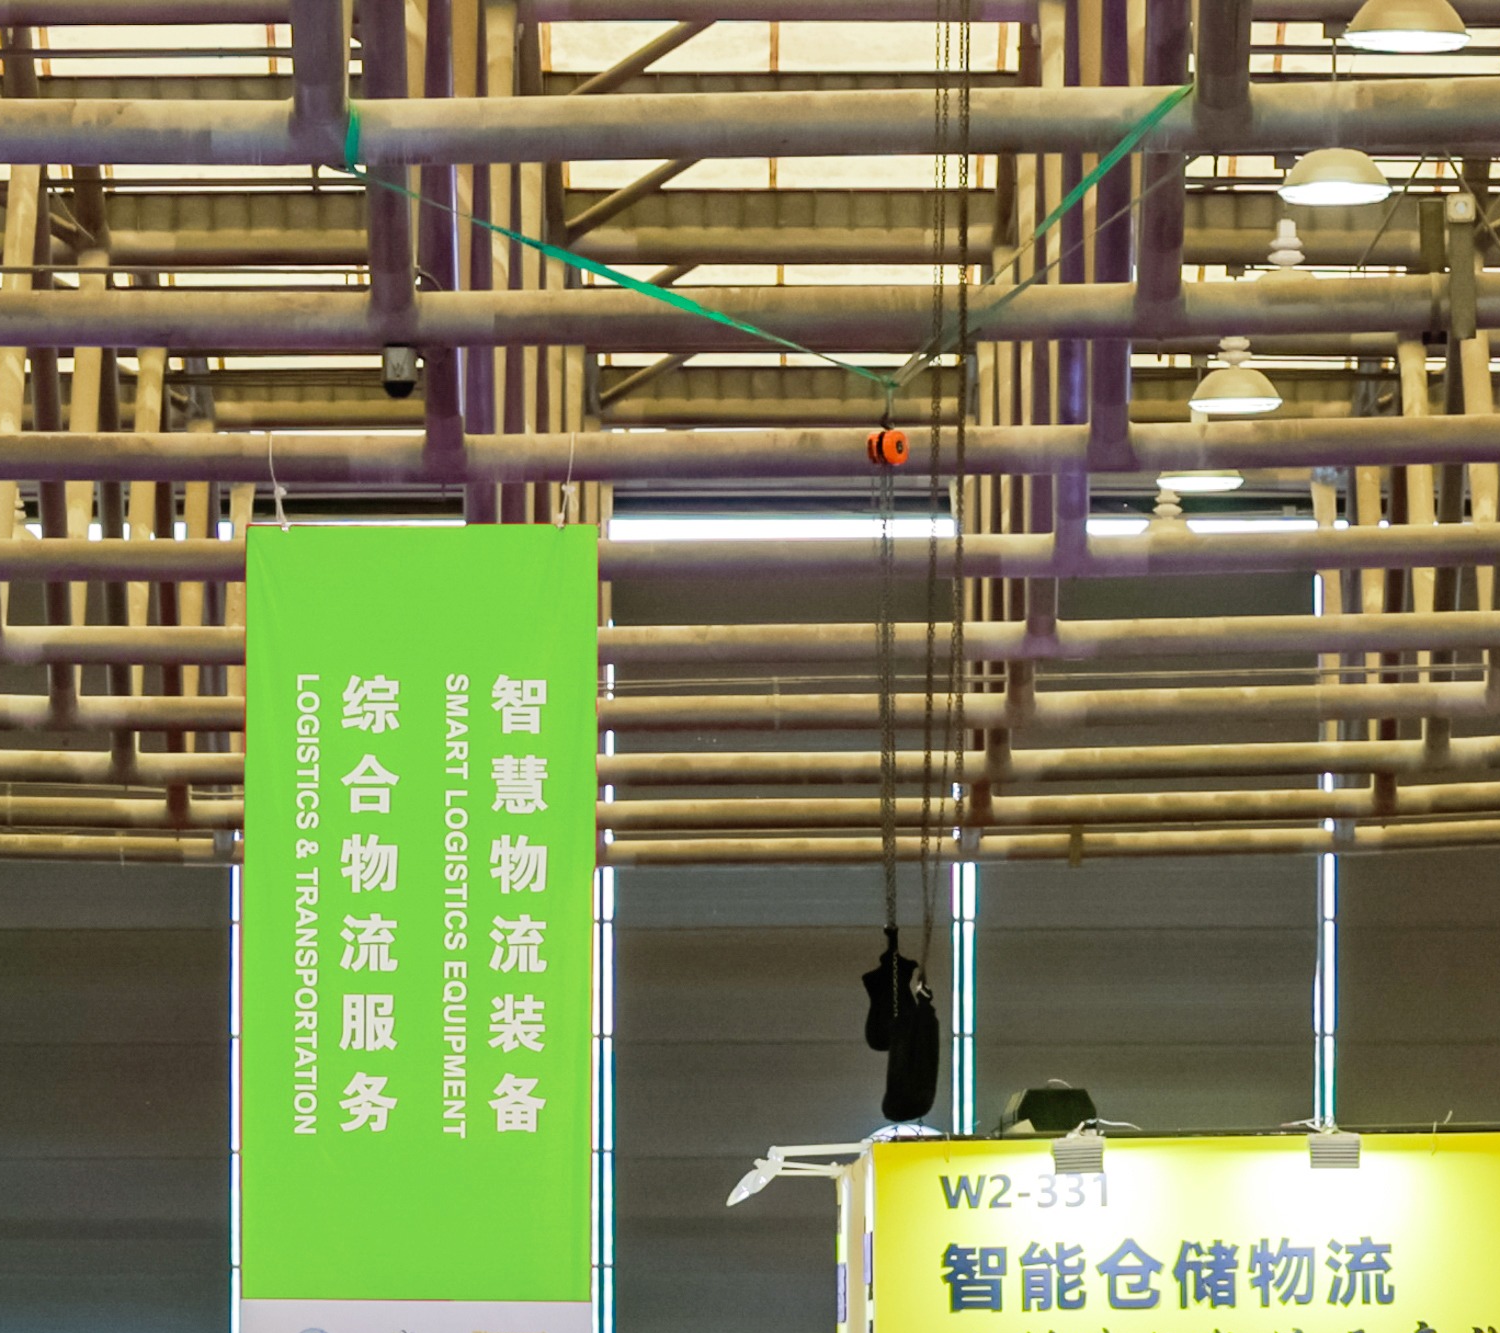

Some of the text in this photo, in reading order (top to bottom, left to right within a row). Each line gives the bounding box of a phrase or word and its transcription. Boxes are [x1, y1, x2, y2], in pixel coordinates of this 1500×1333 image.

[293, 673, 320, 1136] LOGISTICS & TRANSPORTATION
[339, 674, 400, 1135] 综合物流服务
[442, 673, 470, 1140] SMART LOGISTICS EQUIPMENT
[488, 674, 549, 1134] 智慧物流装备
[939, 1172, 1110, 1210] W2-331
[940, 1236, 1397, 1312] 智能仓储物流
